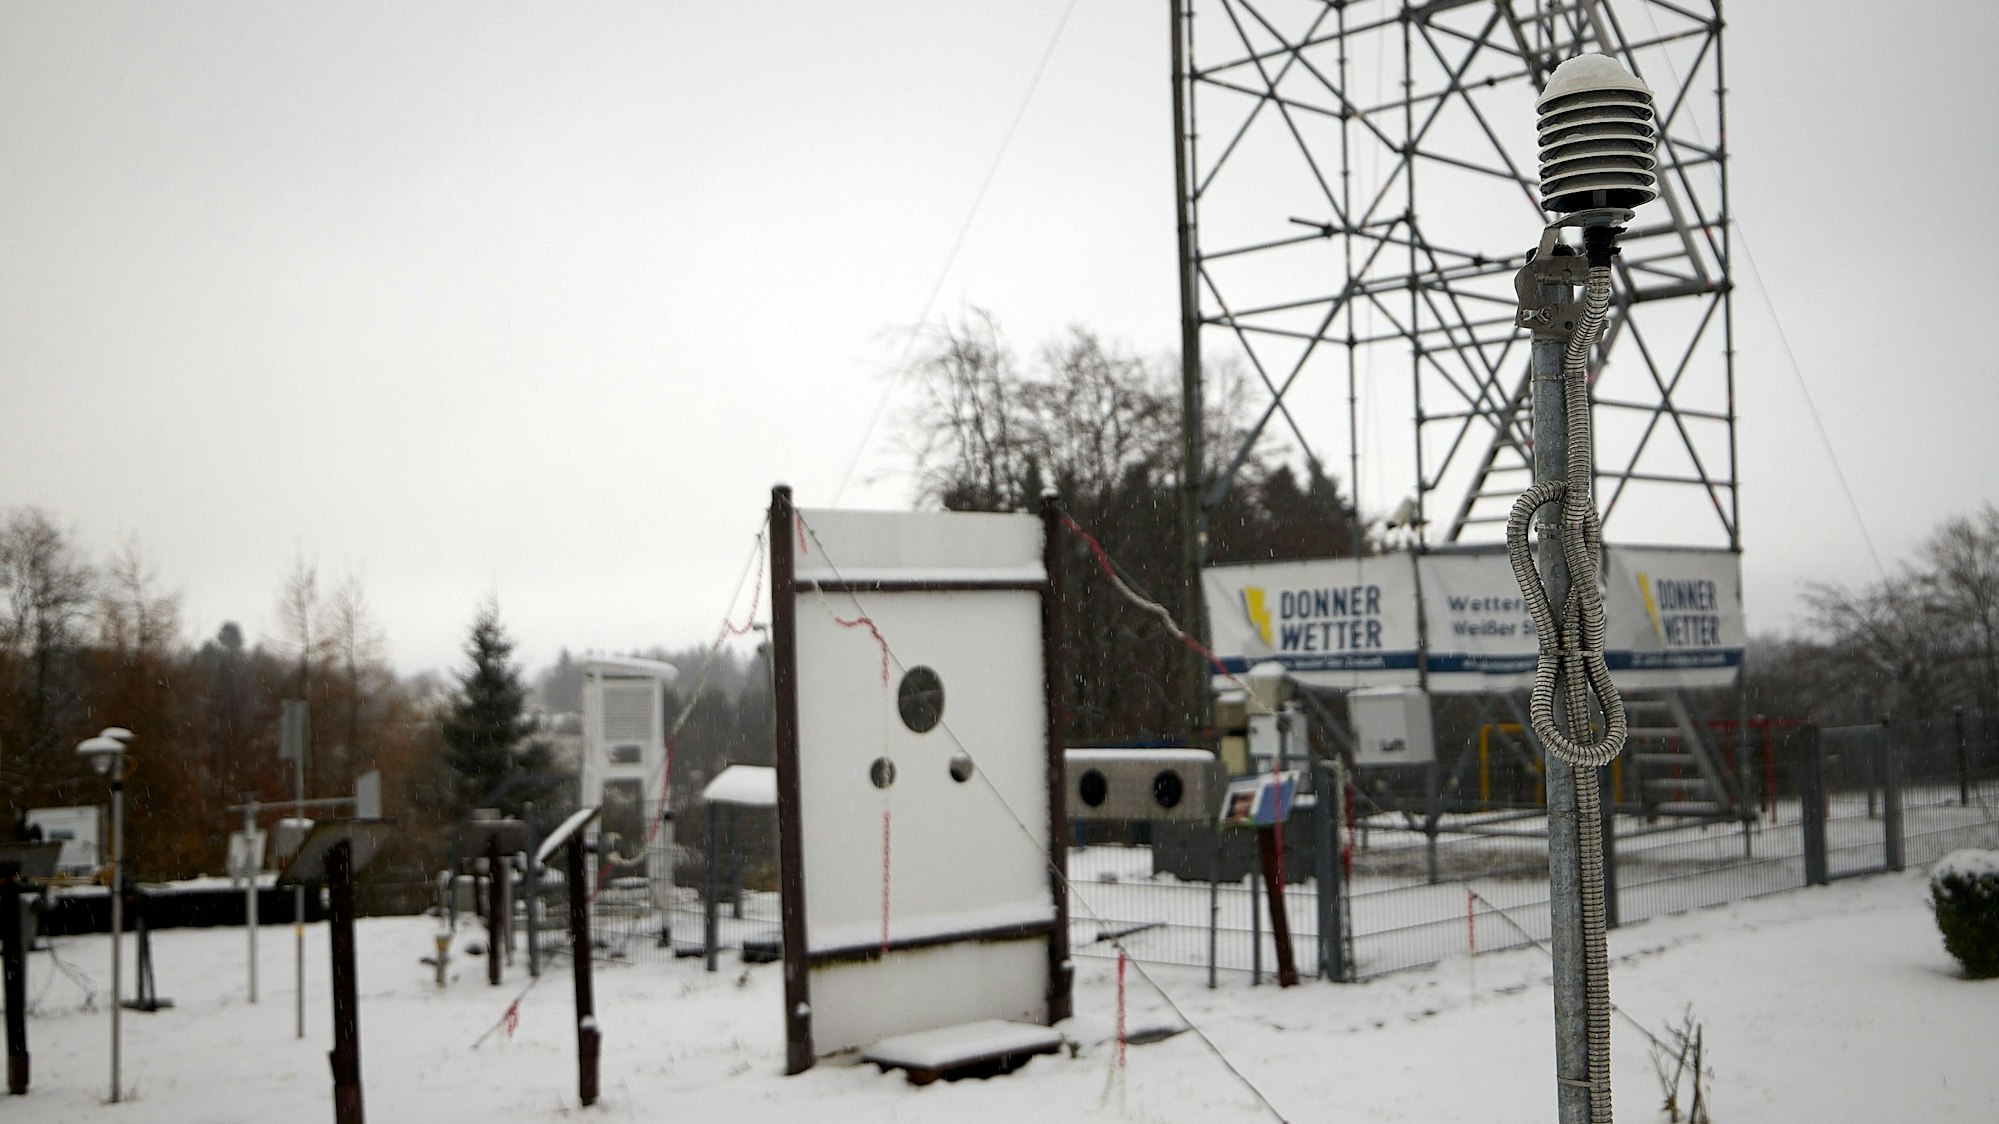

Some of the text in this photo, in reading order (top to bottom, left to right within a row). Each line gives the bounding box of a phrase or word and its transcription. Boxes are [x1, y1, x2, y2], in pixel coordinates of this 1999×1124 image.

[1280, 585, 1381, 619] DONNER
[1657, 579, 1718, 610] DONNER
[1281, 619, 1382, 651] WETTER
[1451, 619, 1517, 636] Weißer
[1662, 615, 1721, 646] WETTER
